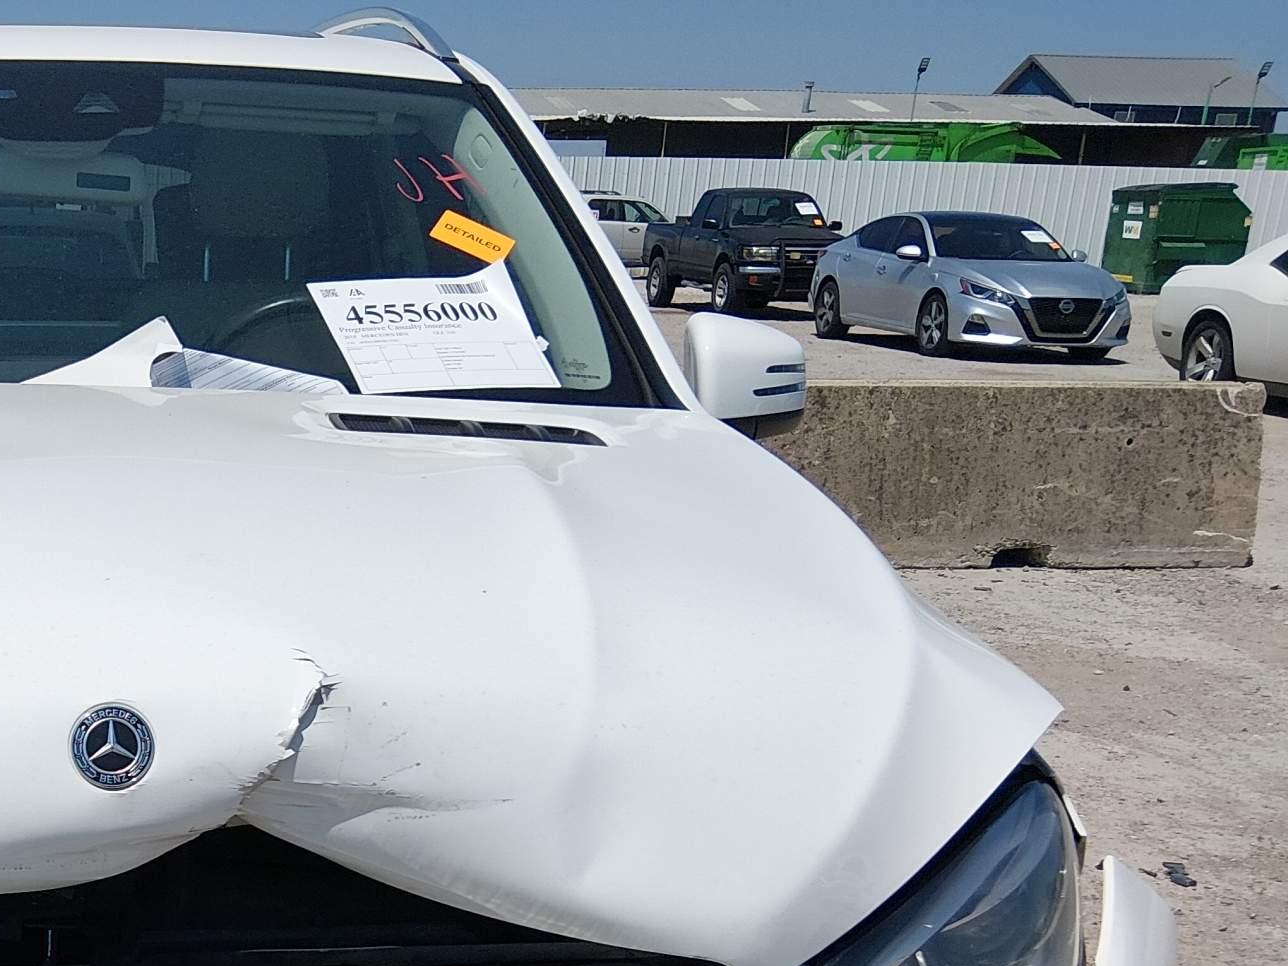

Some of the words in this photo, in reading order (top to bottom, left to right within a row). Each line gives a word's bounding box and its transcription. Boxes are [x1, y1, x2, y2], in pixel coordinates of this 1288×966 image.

[444, 222, 502, 253] DETAILED
[346, 301, 499, 325] 45556000
[338, 326, 386, 334] Progressive
[83, 708, 138, 727] MERCEDES
[99, 773, 129, 785] BENZ
